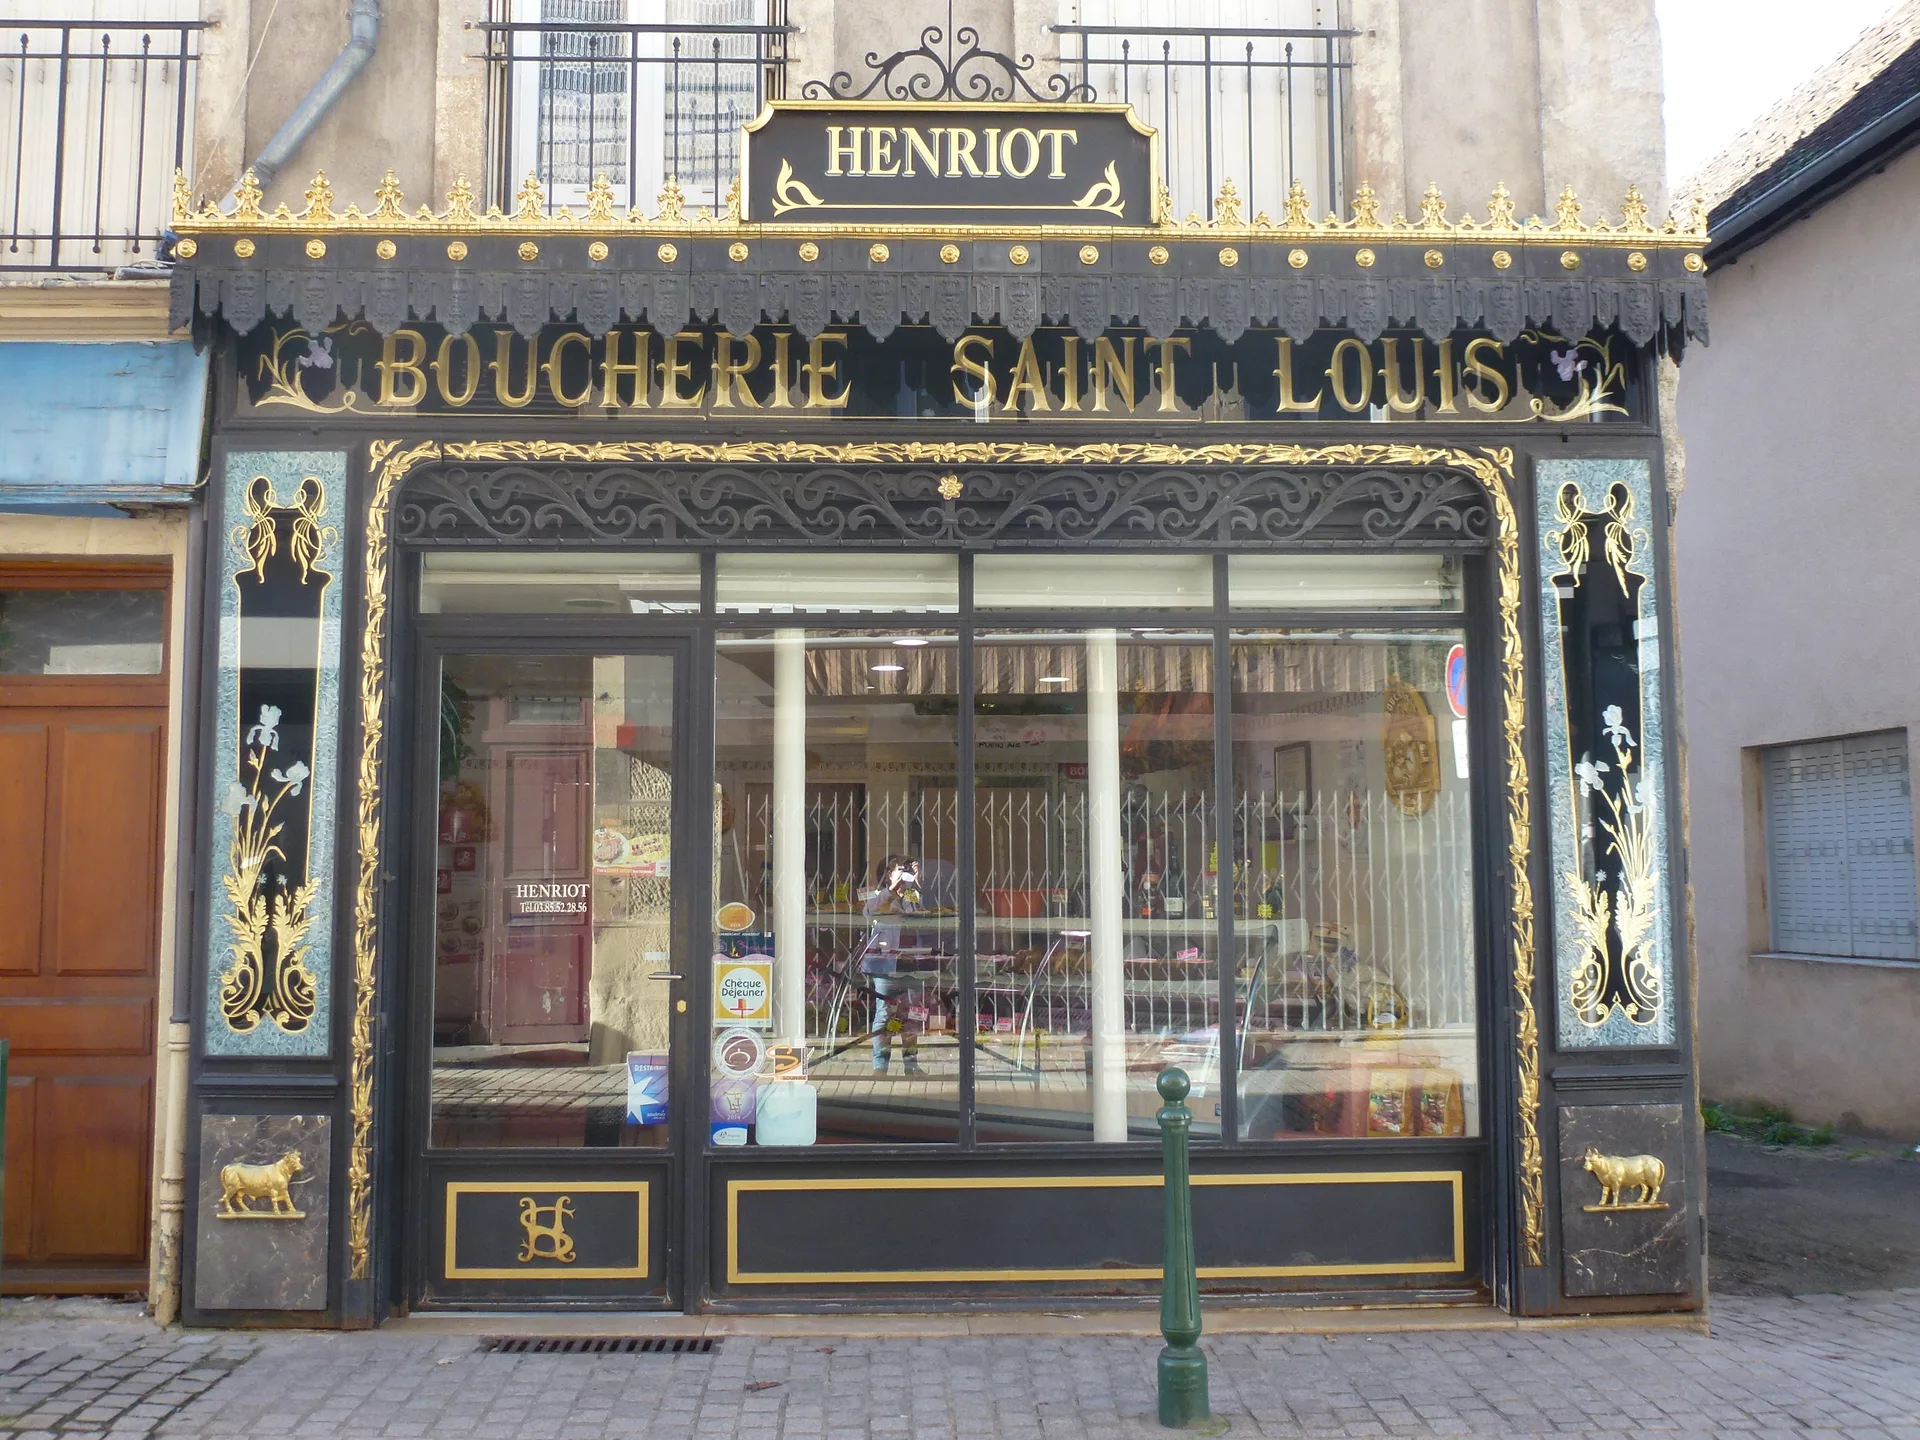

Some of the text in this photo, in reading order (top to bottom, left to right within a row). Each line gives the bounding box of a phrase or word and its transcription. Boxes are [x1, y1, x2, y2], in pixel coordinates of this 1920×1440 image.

[825, 126, 1078, 178] HENRIOT
[374, 328, 1510, 414] BOUCHERIE SAINT LOUIS
[516, 884, 590, 898] HENRIOT
[724, 978, 762, 989] Chèque
[721, 987, 765, 999] Déjeuner
